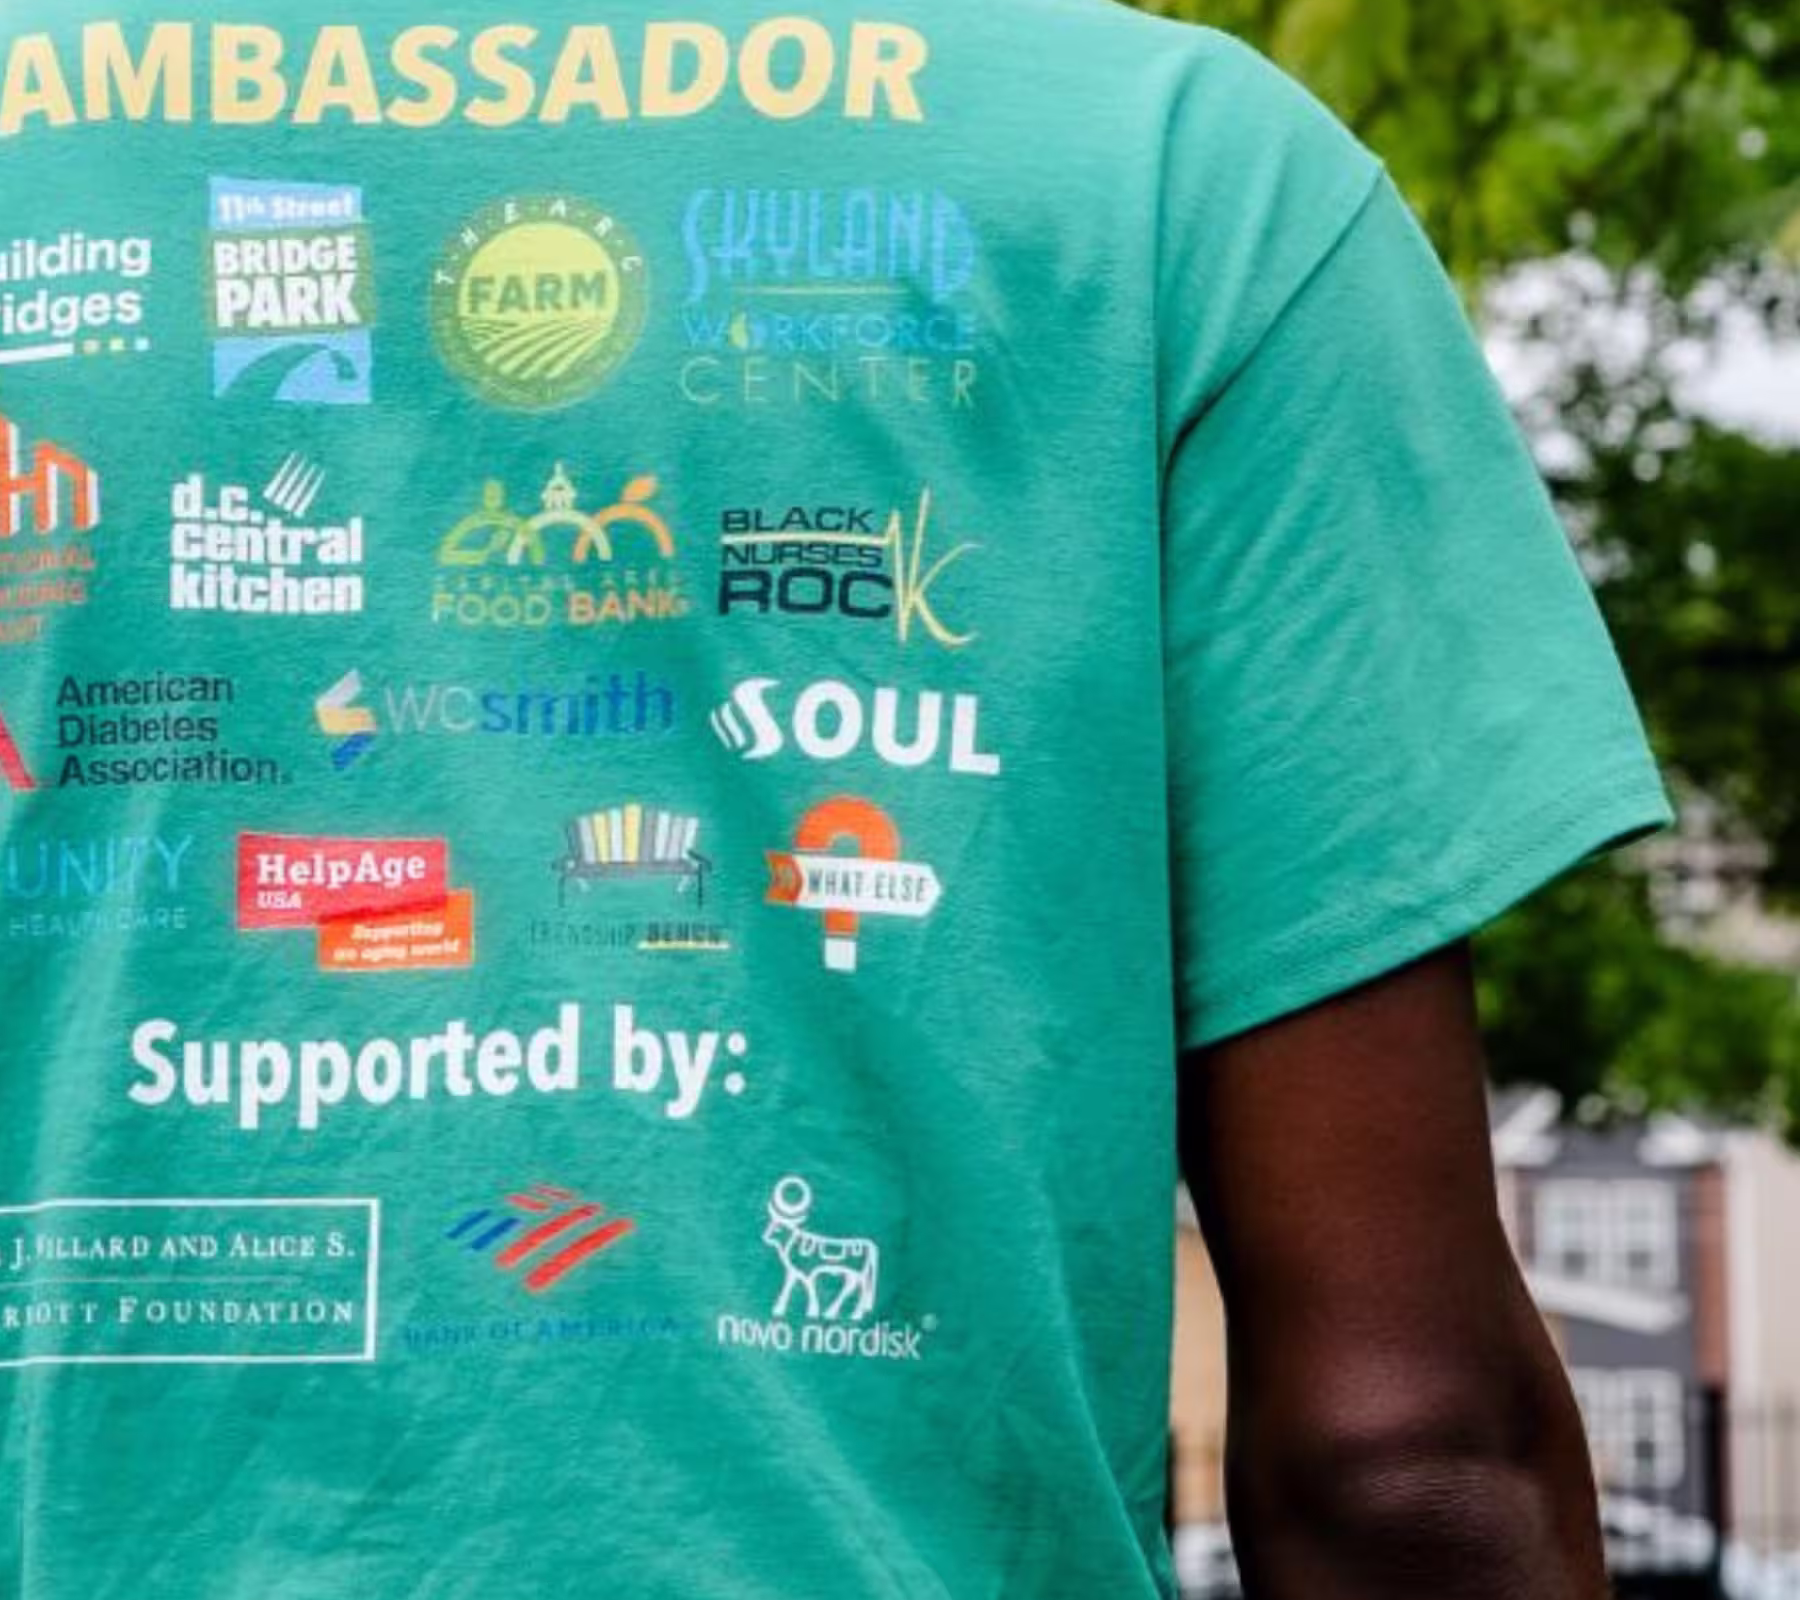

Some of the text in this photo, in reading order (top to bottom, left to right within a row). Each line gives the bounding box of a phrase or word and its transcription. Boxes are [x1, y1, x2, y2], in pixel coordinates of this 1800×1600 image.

[272, 191, 354, 220] Street
[214, 235, 358, 275] BRIDGE
[681, 188, 975, 303] SKYLAND
[215, 272, 361, 328] PARK
[468, 271, 607, 314] FARM
[682, 306, 975, 351] WORKFORCE
[680, 355, 978, 407] CENTER
[170, 473, 264, 521] d.c.
[170, 515, 363, 565] central
[721, 506, 875, 533] BLACK
[721, 542, 884, 569] NURSES
[170, 563, 364, 613] kitchen
[432, 587, 680, 626] FOOD BANK
[56, 671, 235, 707] American
[58, 711, 219, 749] Diabetes
[711, 677, 1001, 777] SOUL
[7, 834, 194, 899] UNITY
[256, 851, 426, 890] HelpAge
[808, 868, 864, 898] WHAT
[874, 871, 929, 904] ELSE
[256, 890, 301, 909] USA
[128, 1000, 748, 1129] Supported by:
[8, 1237, 32, 1271] J.
[159, 1235, 218, 1260] AND
[229, 1232, 316, 1258] ALICE
[326, 1231, 356, 1258] S.
[118, 1295, 353, 1324] FOUNDATION
[717, 1314, 922, 1360] novo nordisk
